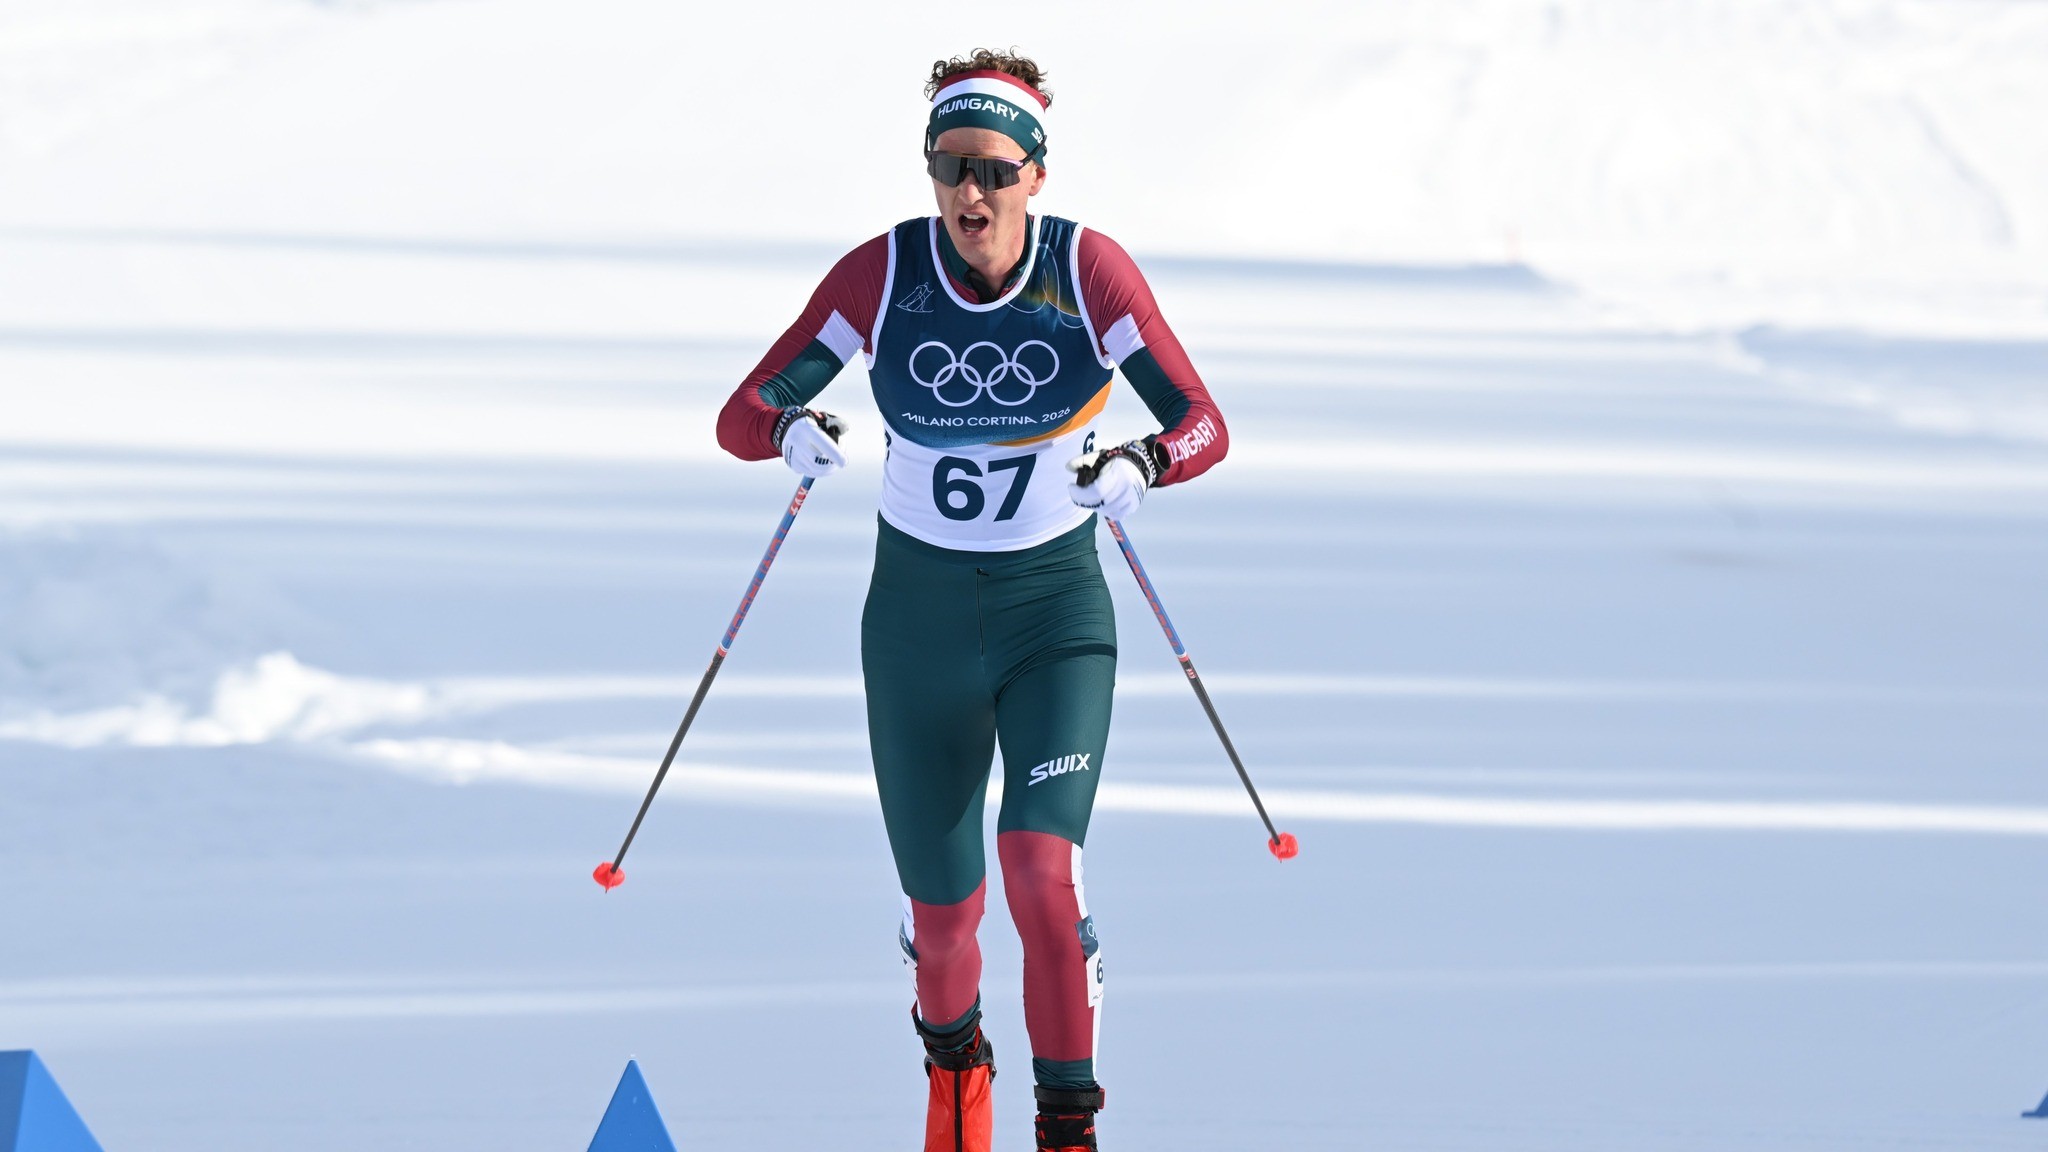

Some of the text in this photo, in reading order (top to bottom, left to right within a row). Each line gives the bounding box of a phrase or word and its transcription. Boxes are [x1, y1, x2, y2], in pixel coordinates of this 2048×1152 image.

[938, 98, 1019, 121] HUNGARY
[902, 407, 1071, 427] MILANO CORTINA 2026
[932, 453, 1037, 523] 67
[1028, 753, 1091, 787] SWIX
